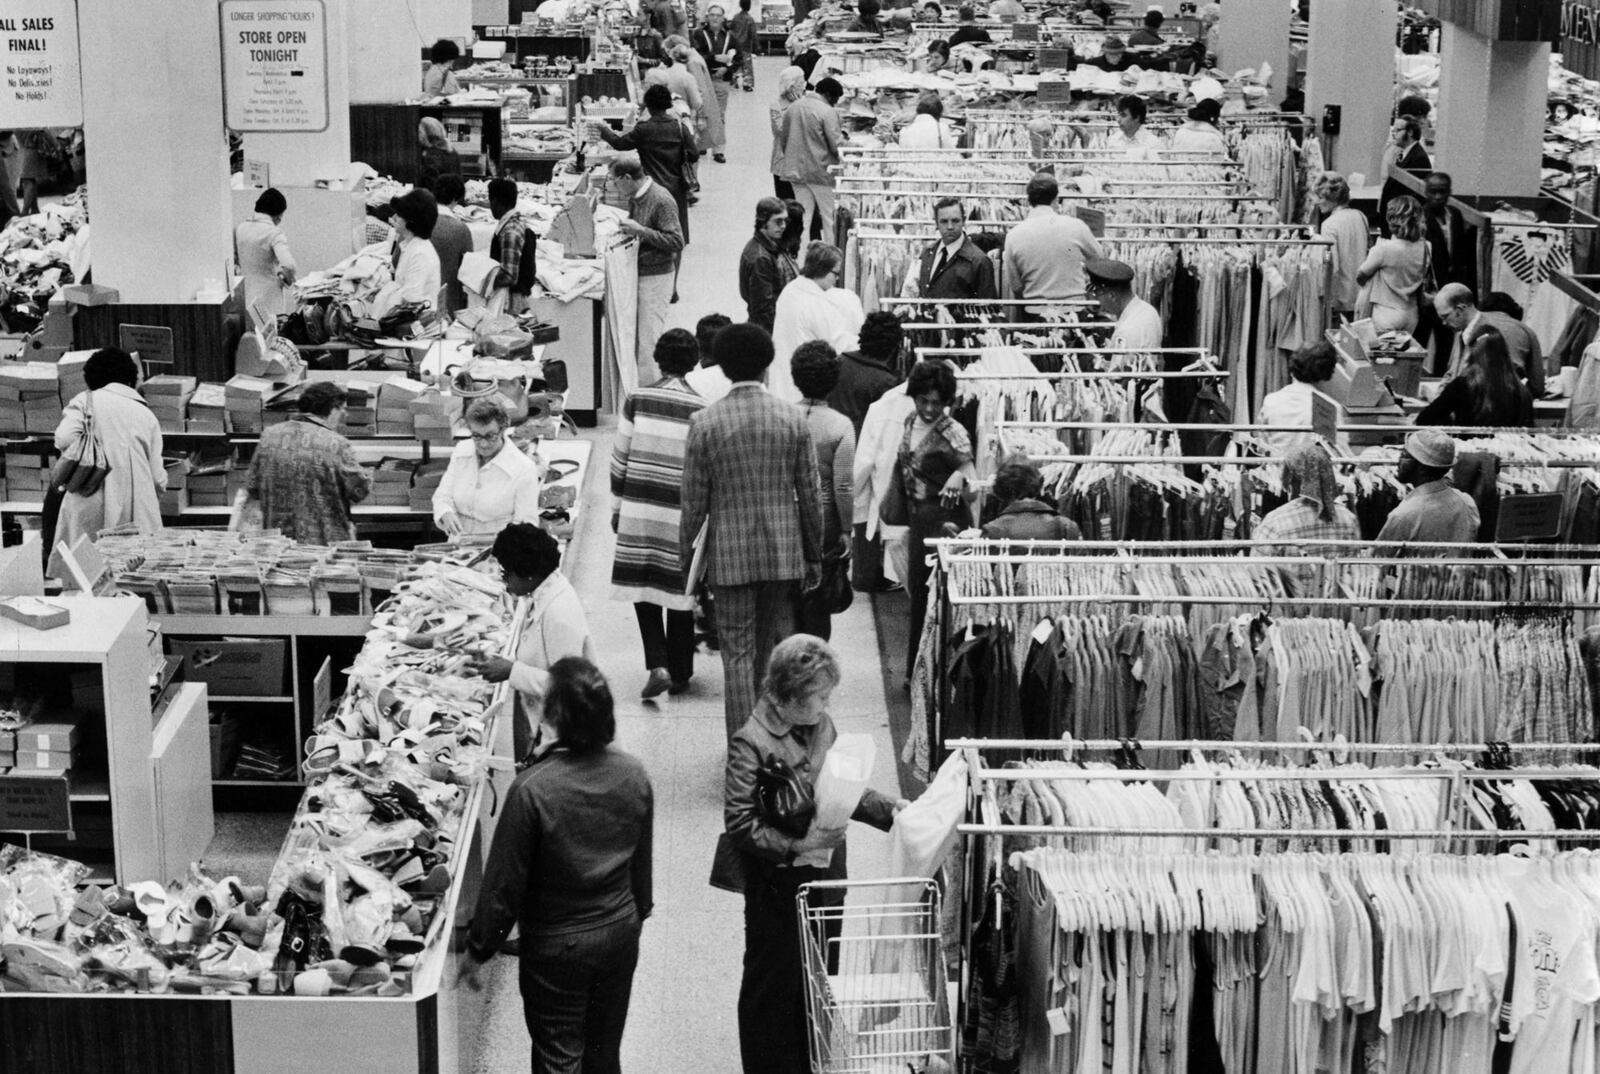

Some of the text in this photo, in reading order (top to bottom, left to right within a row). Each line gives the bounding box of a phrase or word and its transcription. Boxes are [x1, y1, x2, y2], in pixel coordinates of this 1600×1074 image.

[230, 12, 254, 21] LONGER
[257, 12, 288, 21] SHOPPING
[0, 18, 54, 31] ALL SALES
[1560, 0, 1600, 49] MEN
[239, 31, 306, 44] STORE OPEN
[9, 38, 47, 52] FINAL!
[250, 49, 298, 62] TONIGHT
[7, 65, 52, 77] No Layaways!
[8, 78, 17, 88] No
[15, 91, 47, 102] No Holds!
